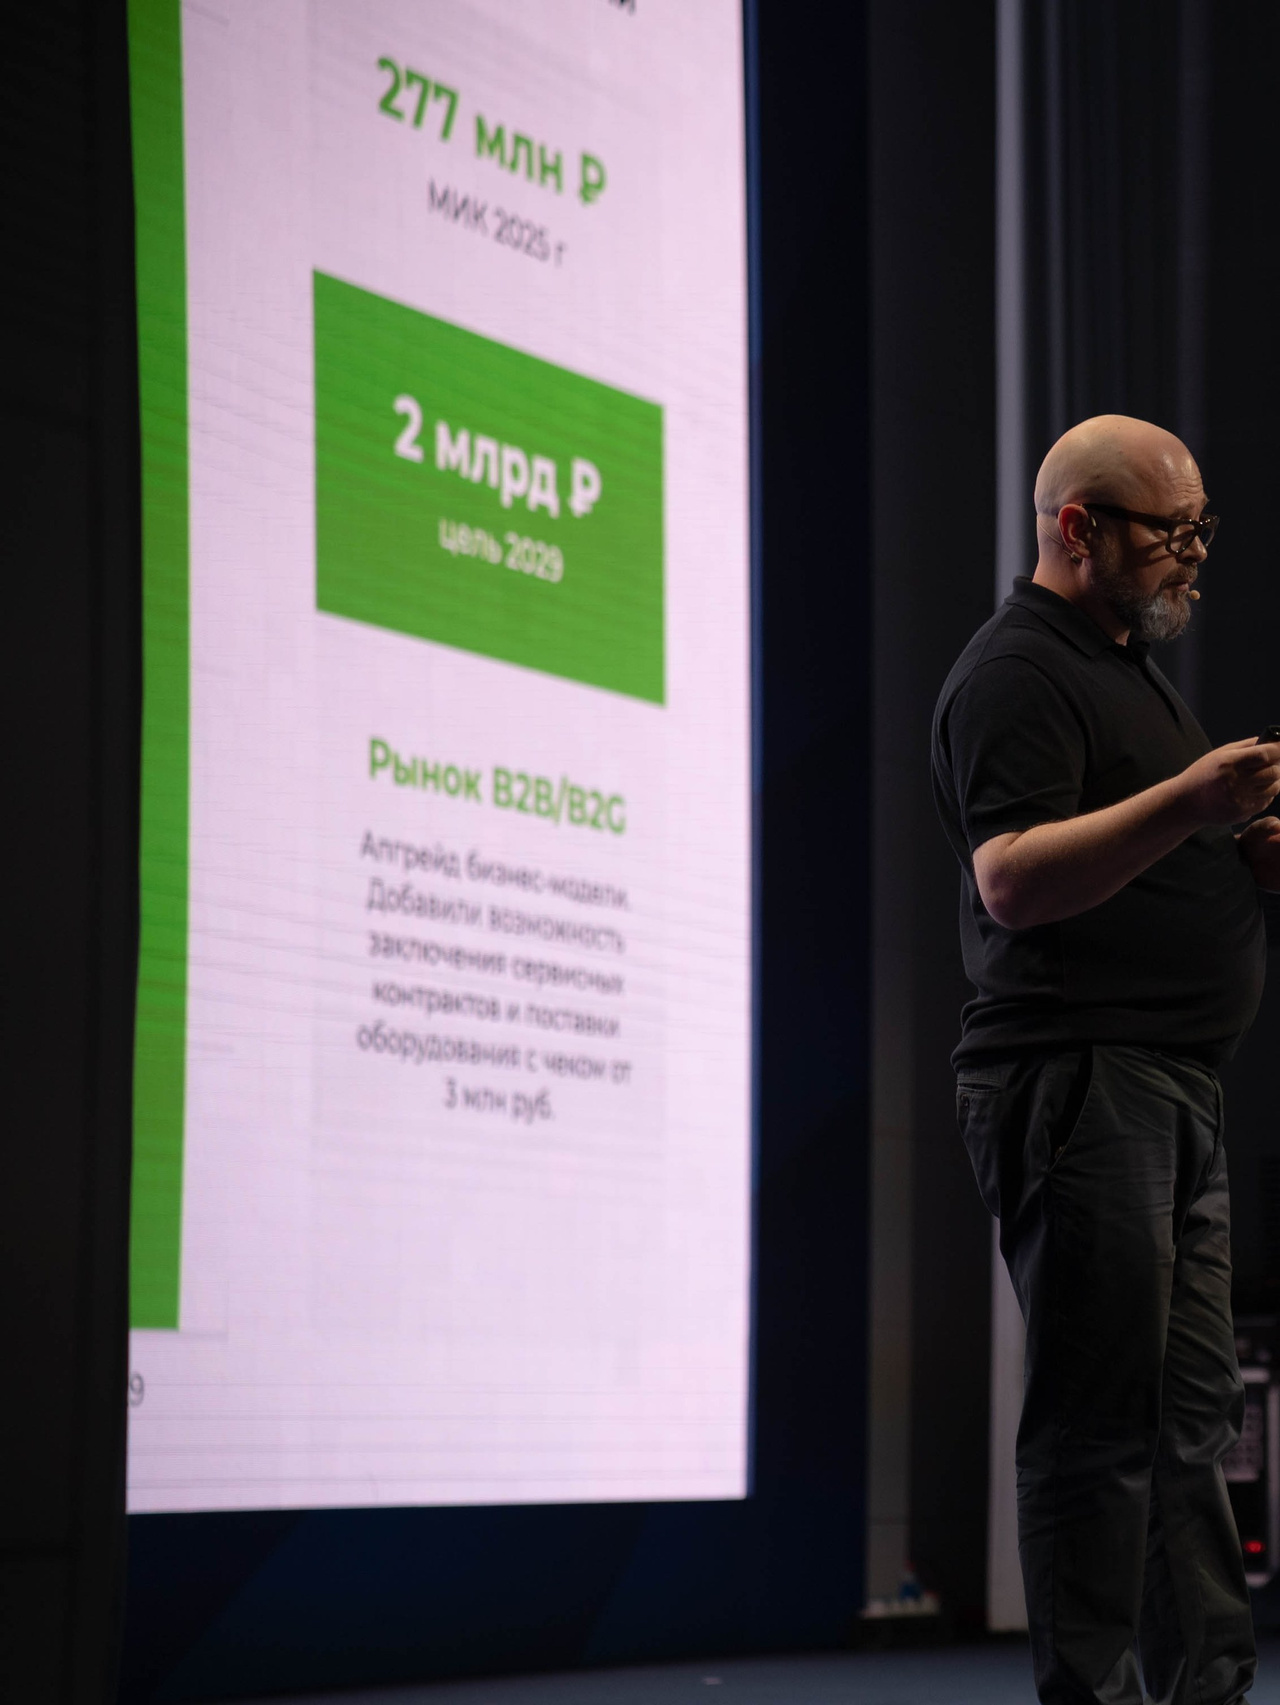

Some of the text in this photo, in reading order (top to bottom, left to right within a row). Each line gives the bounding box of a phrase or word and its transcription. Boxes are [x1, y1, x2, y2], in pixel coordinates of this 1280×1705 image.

[378, 55, 459, 140] 277
[476, 113, 563, 195] млн
[428, 179, 488, 236] МИК
[494, 209, 550, 262] 2025
[393, 394, 423, 463] 2
[435, 419, 560, 519] млрд
[439, 518, 564, 583] цель 2029
[368, 736, 482, 802] Рынок
[361, 829, 461, 881] Апгрейд
[366, 877, 626, 955] Добавили возможность
[368, 930, 625, 996] заключения сервисных
[372, 982, 620, 1038] контрактов и поставки
[356, 1019, 632, 1084] оборудования с чеком от
[445, 1075, 457, 1110] 3
[463, 1085, 507, 1113] млн
